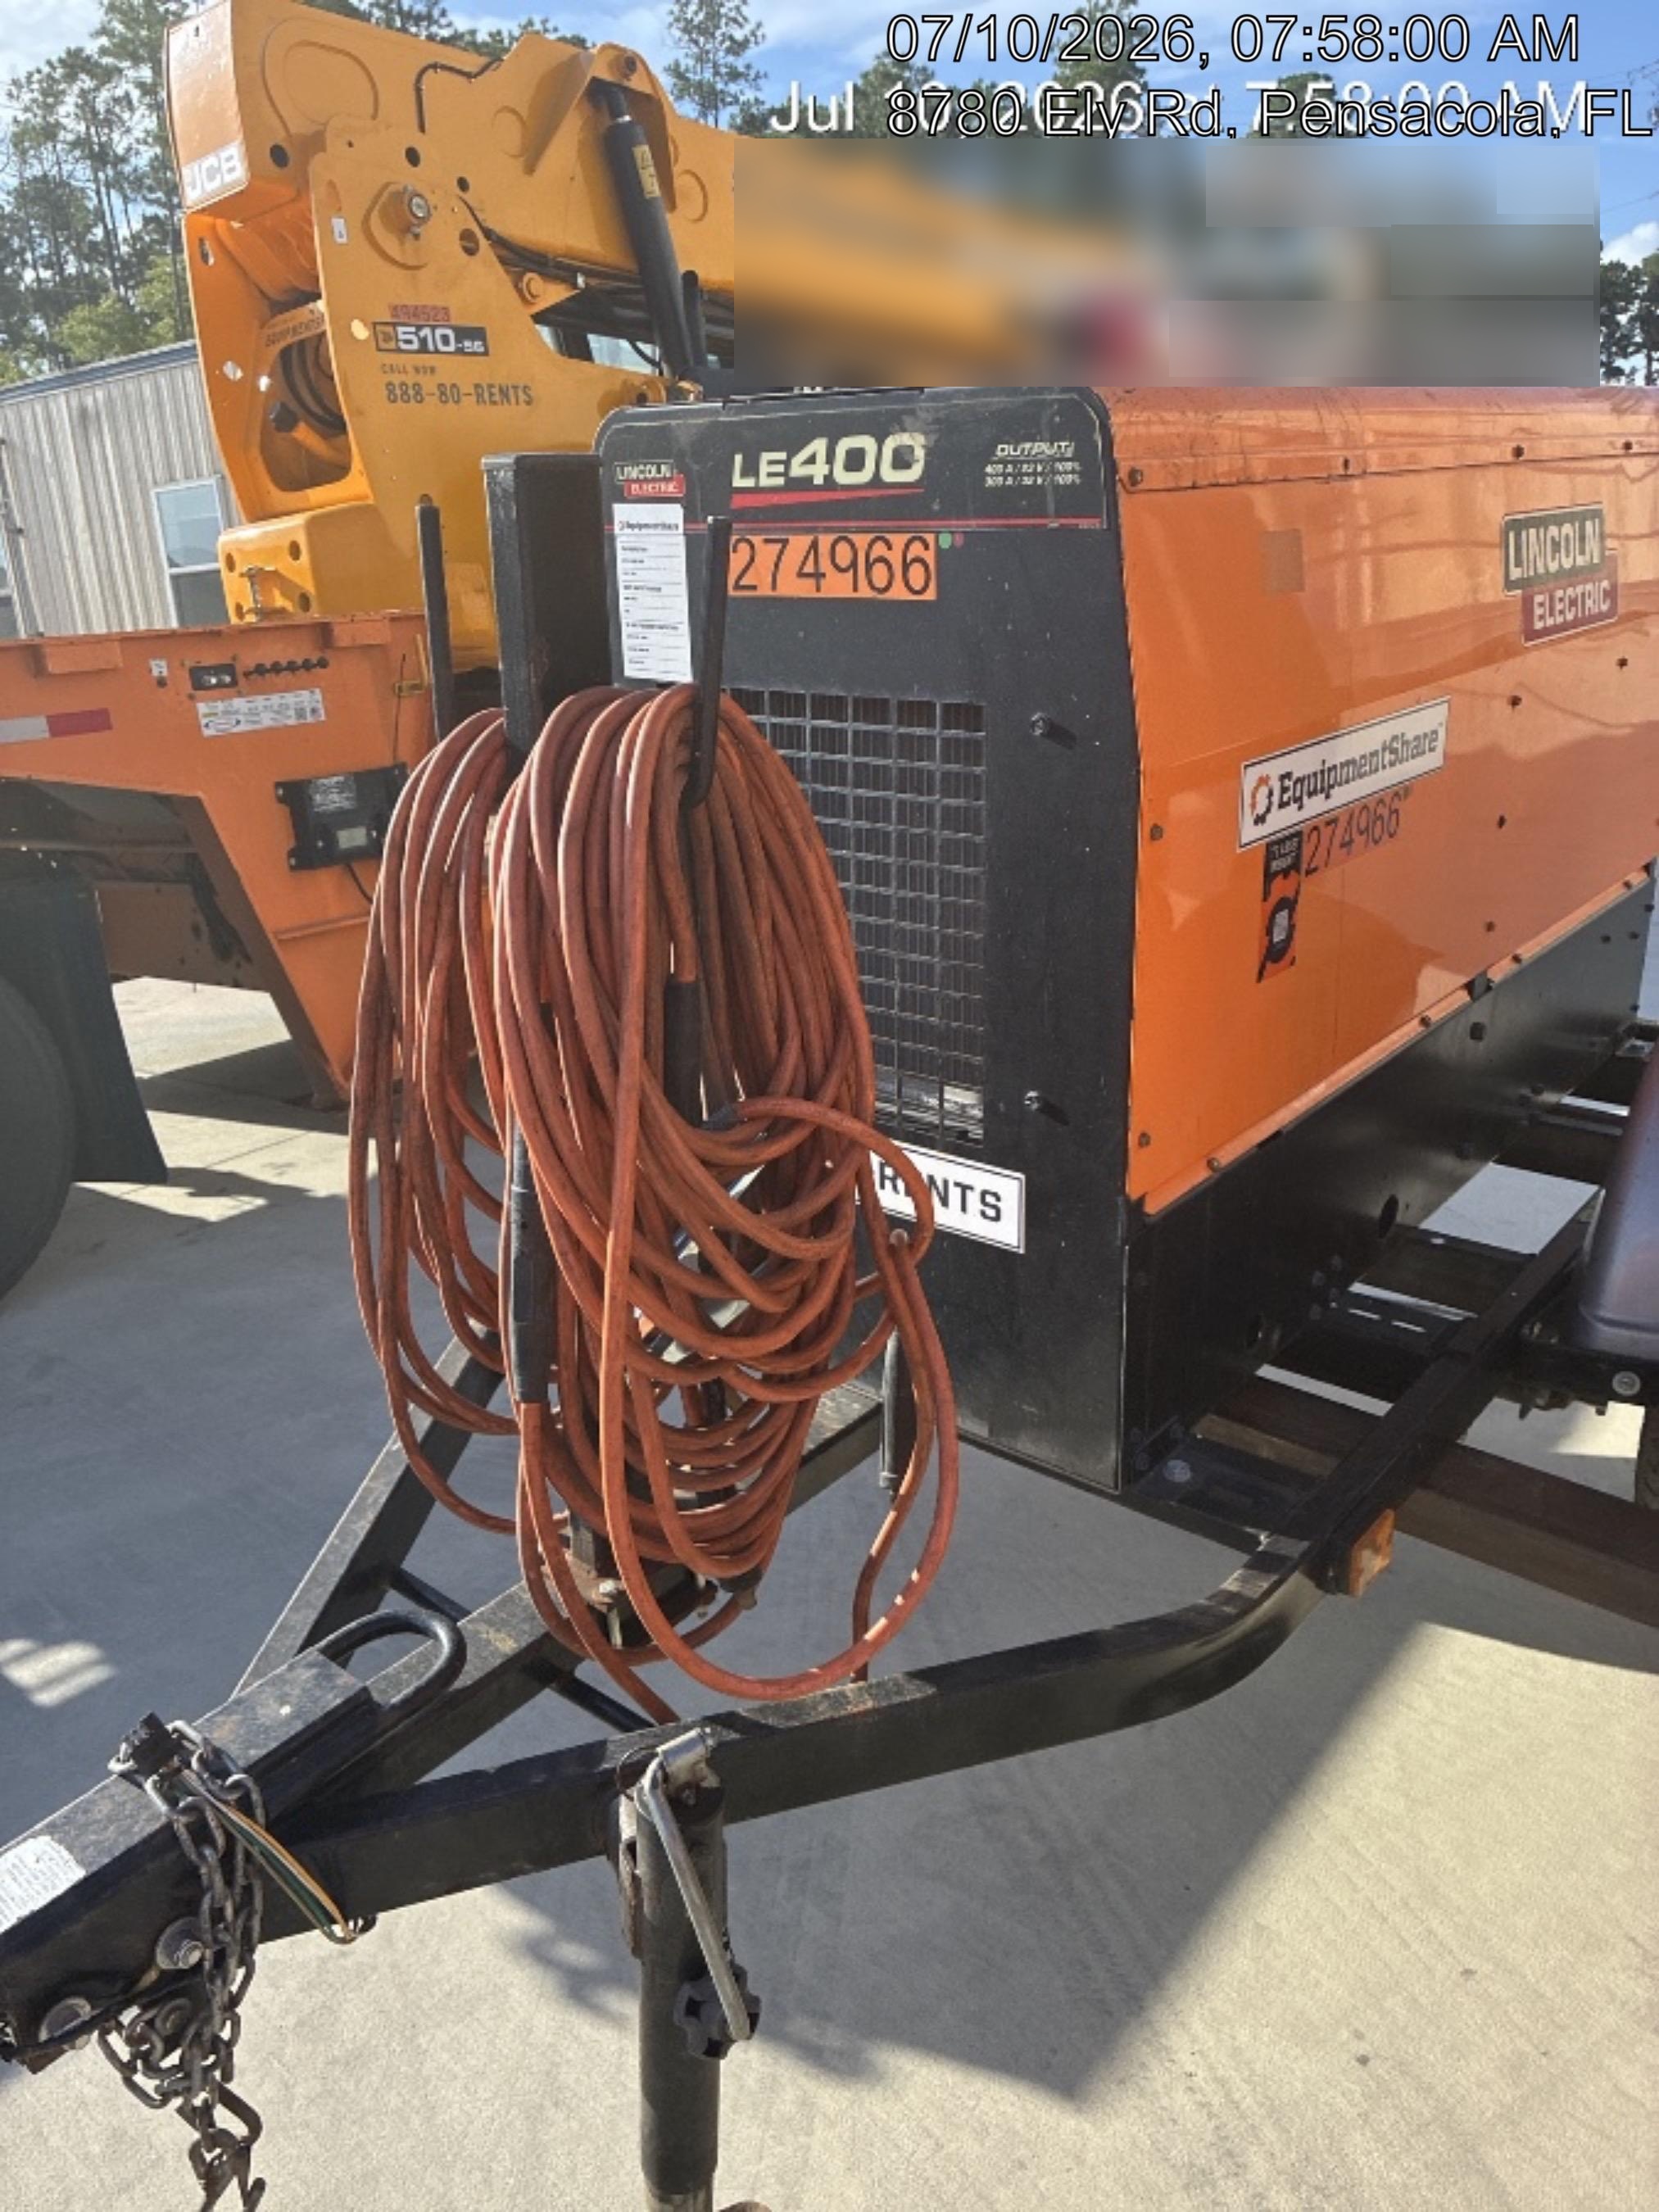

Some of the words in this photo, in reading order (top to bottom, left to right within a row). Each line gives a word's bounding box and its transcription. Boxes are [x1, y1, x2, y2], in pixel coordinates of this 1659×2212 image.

[184, 145, 243, 201] JCB
[385, 381, 533, 406] 888-80-RENTS
[616, 463, 672, 480] LINCOLN
[732, 432, 927, 488] LE400
[732, 535, 932, 596] 274966
[1508, 517, 1601, 581] LINCOLN
[1533, 579, 1611, 630] ELECTRIC
[1278, 728, 1440, 812] EquipmentShare
[1304, 791, 1401, 878] 274966
[879, 1159, 1002, 1223] RNTS
